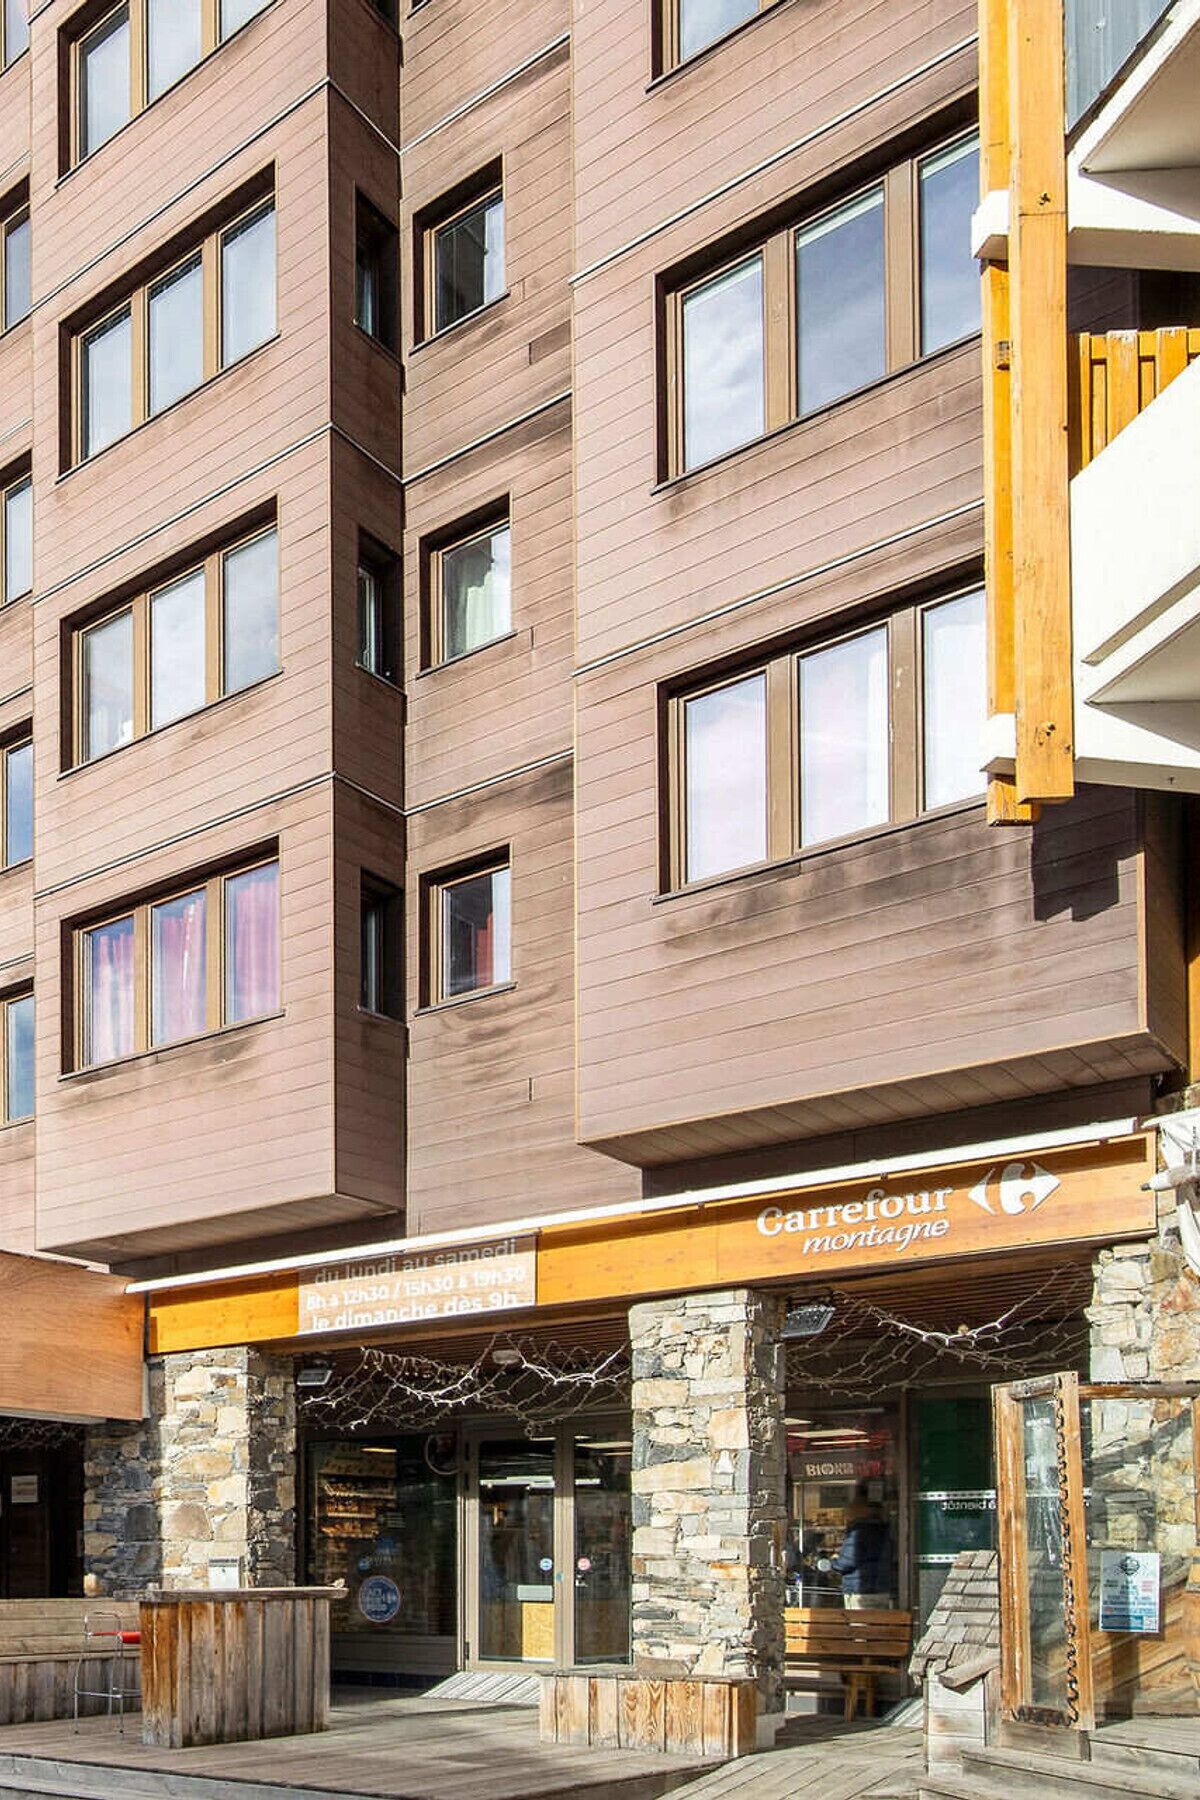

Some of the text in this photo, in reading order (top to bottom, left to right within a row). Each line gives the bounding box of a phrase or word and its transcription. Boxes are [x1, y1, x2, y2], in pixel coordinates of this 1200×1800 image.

[756, 1188, 954, 1237] Carrefour
[802, 1219, 951, 1255] montagne
[315, 1238, 517, 1284] du lundi au samedi
[336, 1300, 439, 1329] dimanche
